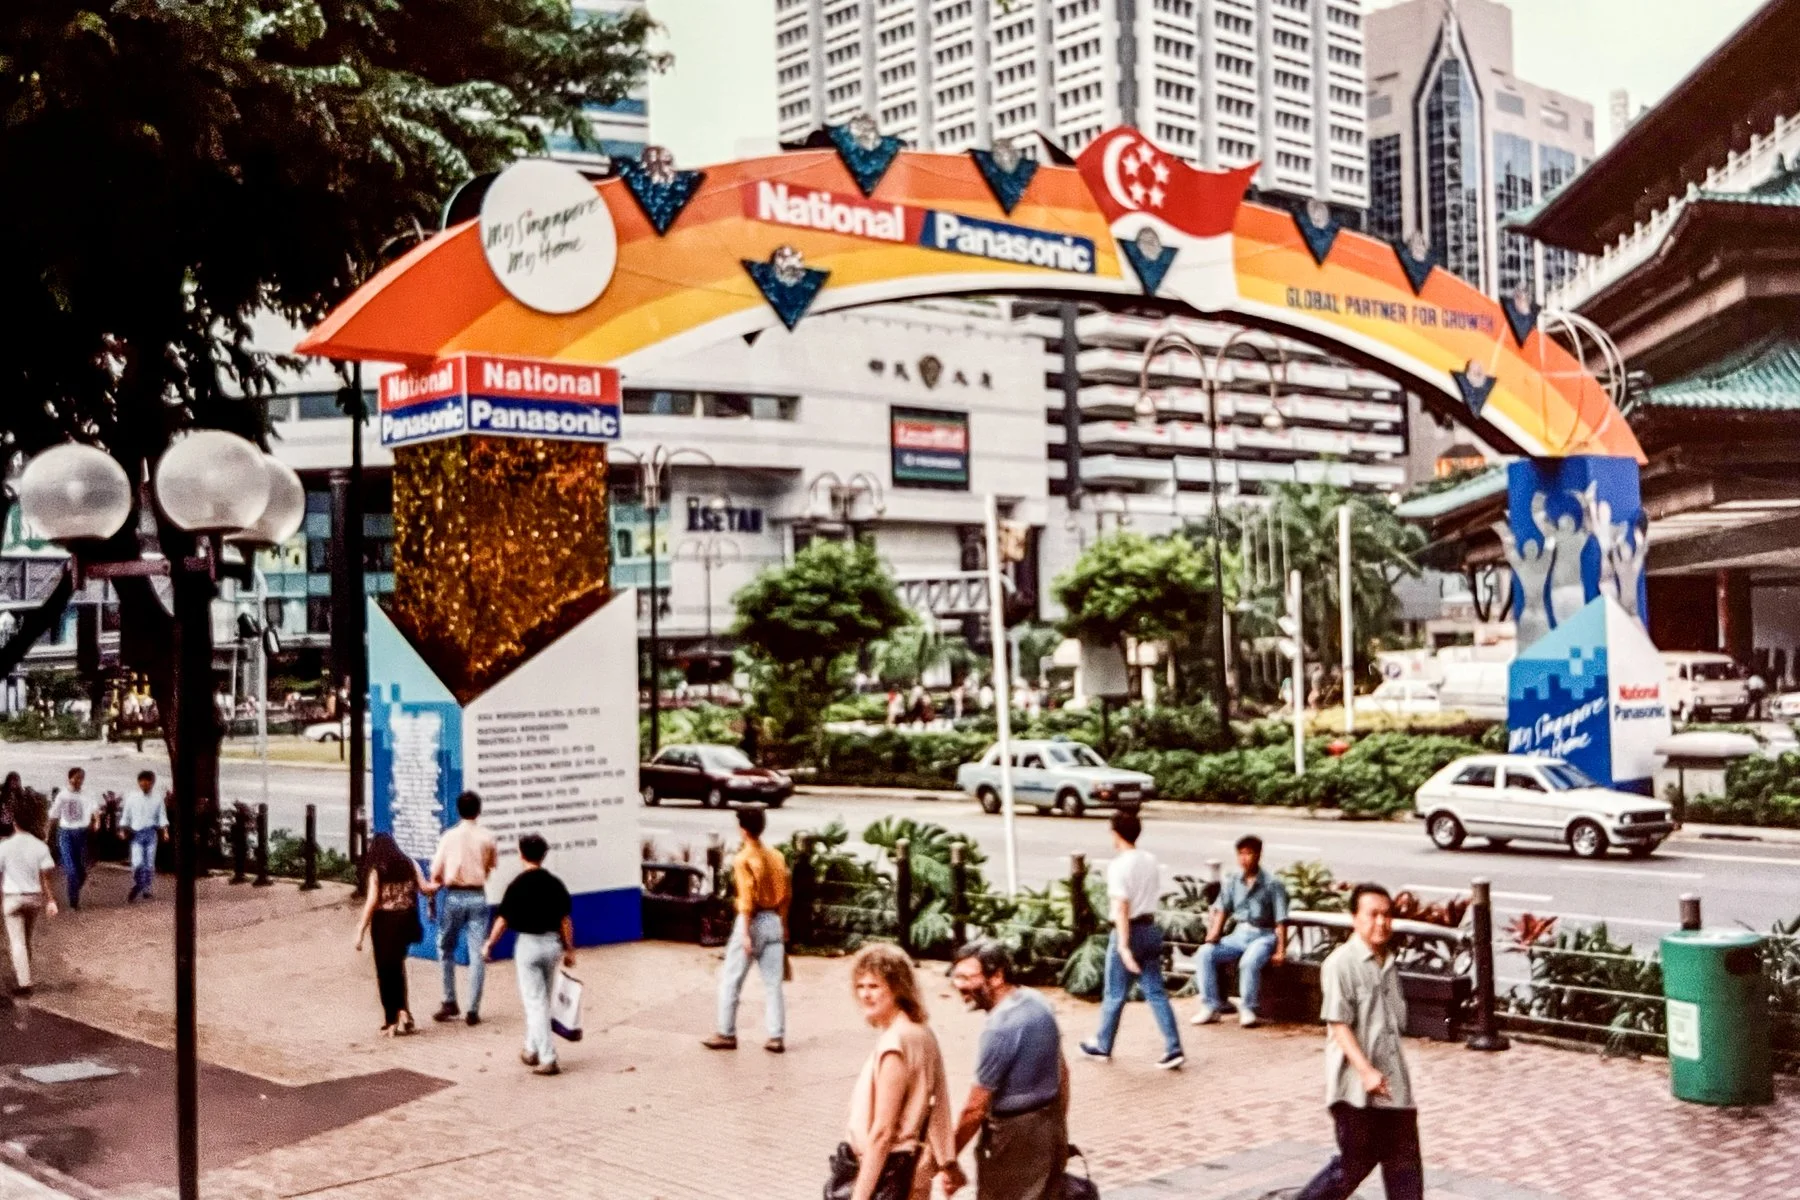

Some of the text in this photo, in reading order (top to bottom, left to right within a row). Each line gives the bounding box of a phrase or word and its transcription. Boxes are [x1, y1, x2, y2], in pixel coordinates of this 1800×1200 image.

[487, 196, 602, 249] My Singapore
[757, 180, 1093, 273] National Panasonic
[507, 237, 587, 275] My Home
[1286, 287, 1494, 333] GLOBAL PARTNER FOR GROWTH
[387, 361, 454, 402] National
[483, 361, 602, 397] National
[382, 402, 464, 441] Panasonic
[470, 399, 618, 436] Panasonic
[1619, 682, 1659, 701] National
[1508, 696, 1608, 753] My Singapore
[1613, 704, 1665, 721] Panasonic
